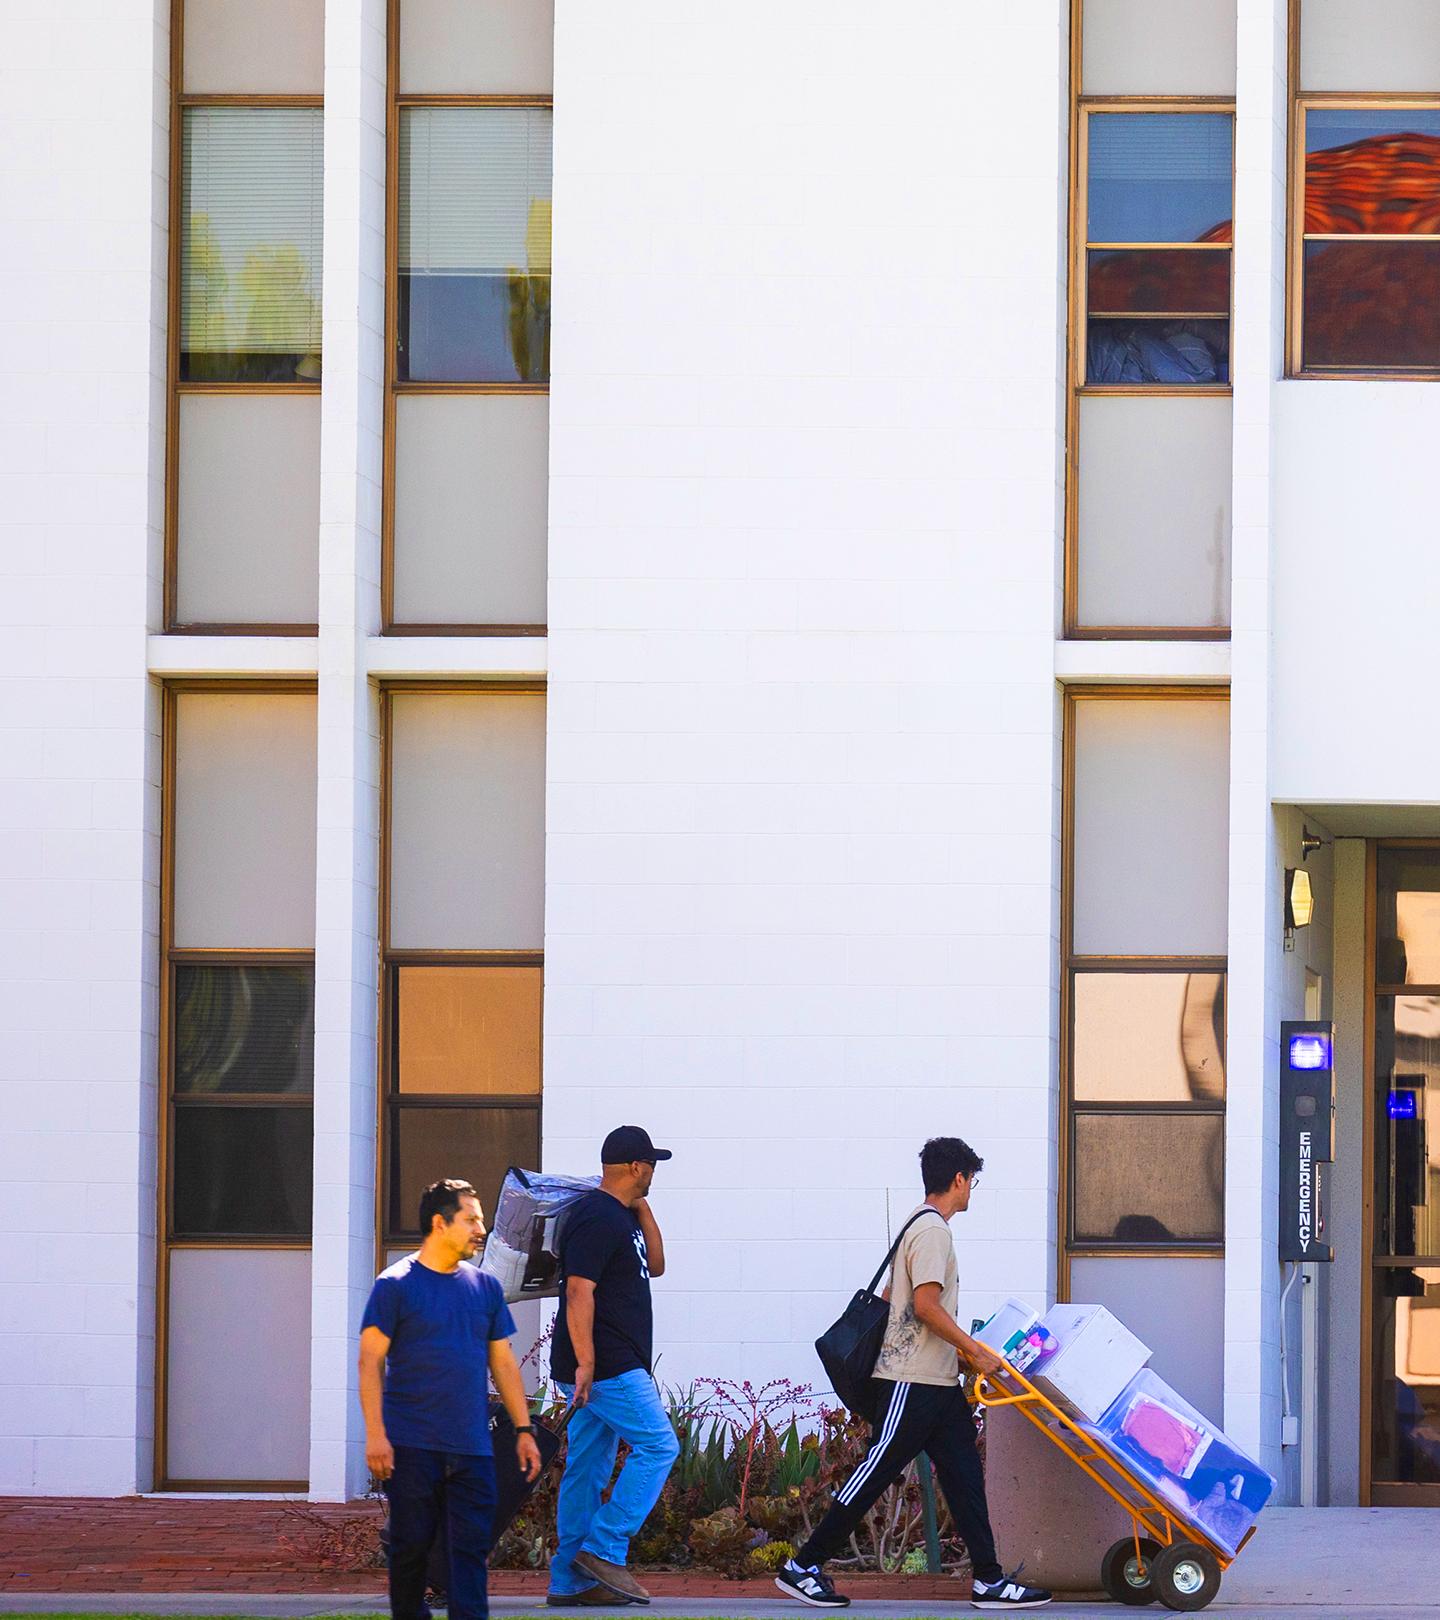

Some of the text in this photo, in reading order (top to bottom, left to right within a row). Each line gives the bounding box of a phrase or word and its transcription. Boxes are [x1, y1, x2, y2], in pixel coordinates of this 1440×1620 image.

[1299, 1132, 1311, 1253] EMERGENCY
[797, 1577, 822, 1596] N
[1000, 1583, 1025, 1600] N
